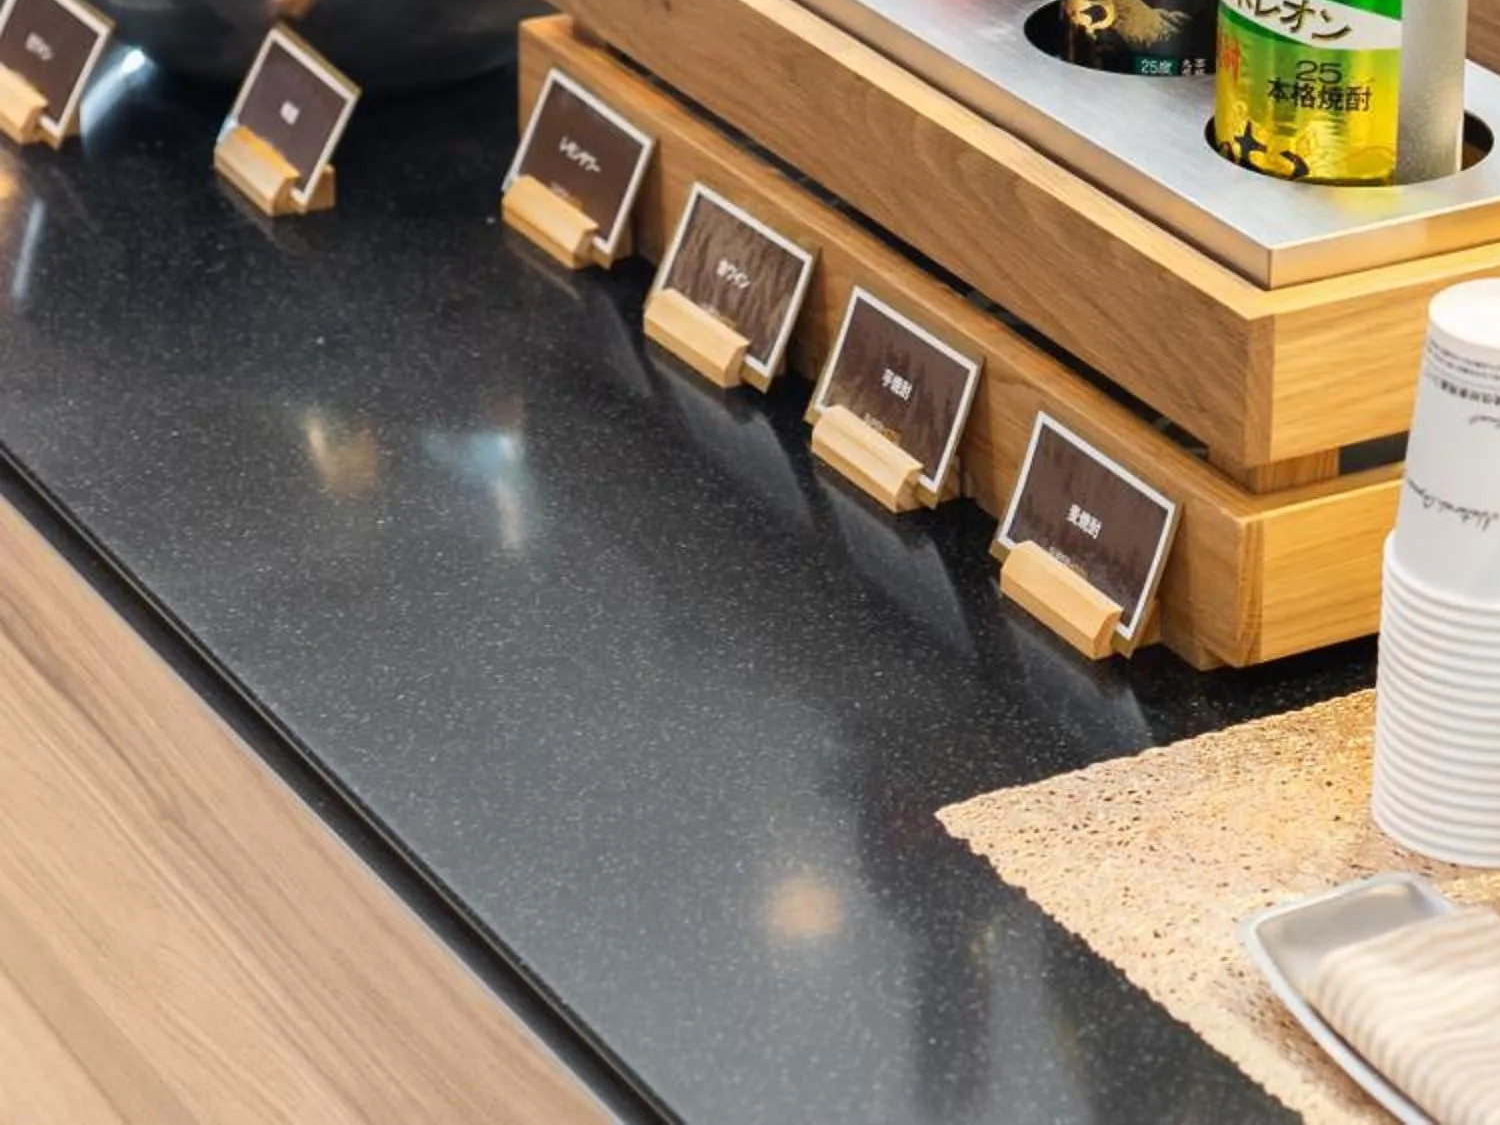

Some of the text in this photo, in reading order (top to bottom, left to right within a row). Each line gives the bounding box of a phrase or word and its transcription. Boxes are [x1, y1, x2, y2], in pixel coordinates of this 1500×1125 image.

[1295, 60, 1343, 84] 25
[1267, 76, 1373, 112] 本格焼酎
